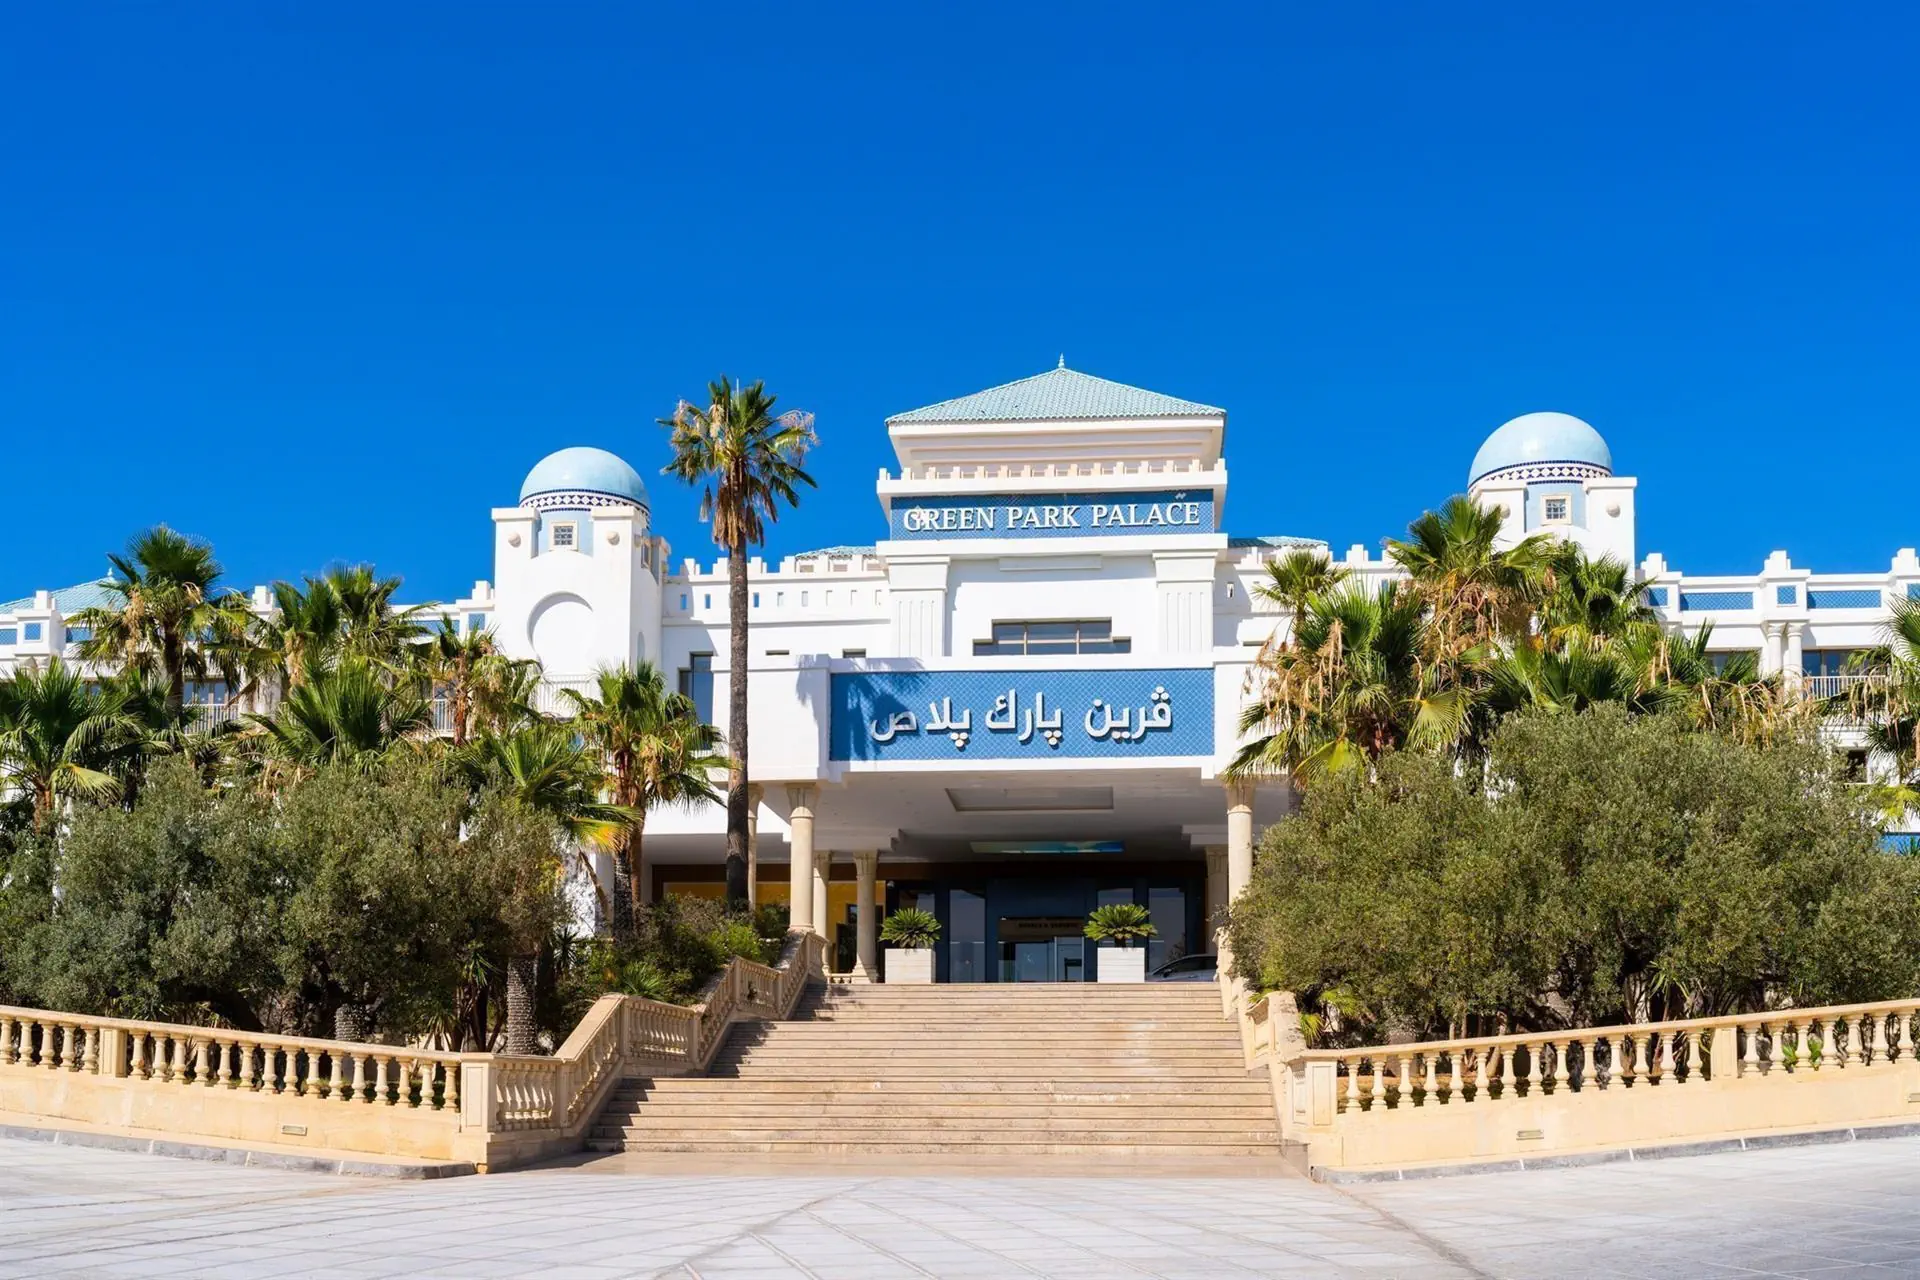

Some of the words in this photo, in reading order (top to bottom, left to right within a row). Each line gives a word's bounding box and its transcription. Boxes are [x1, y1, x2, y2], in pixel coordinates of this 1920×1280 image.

[903, 507, 995, 531] GREEN
[1006, 505, 1081, 529] PARK
[1091, 502, 1200, 526] PALACE
